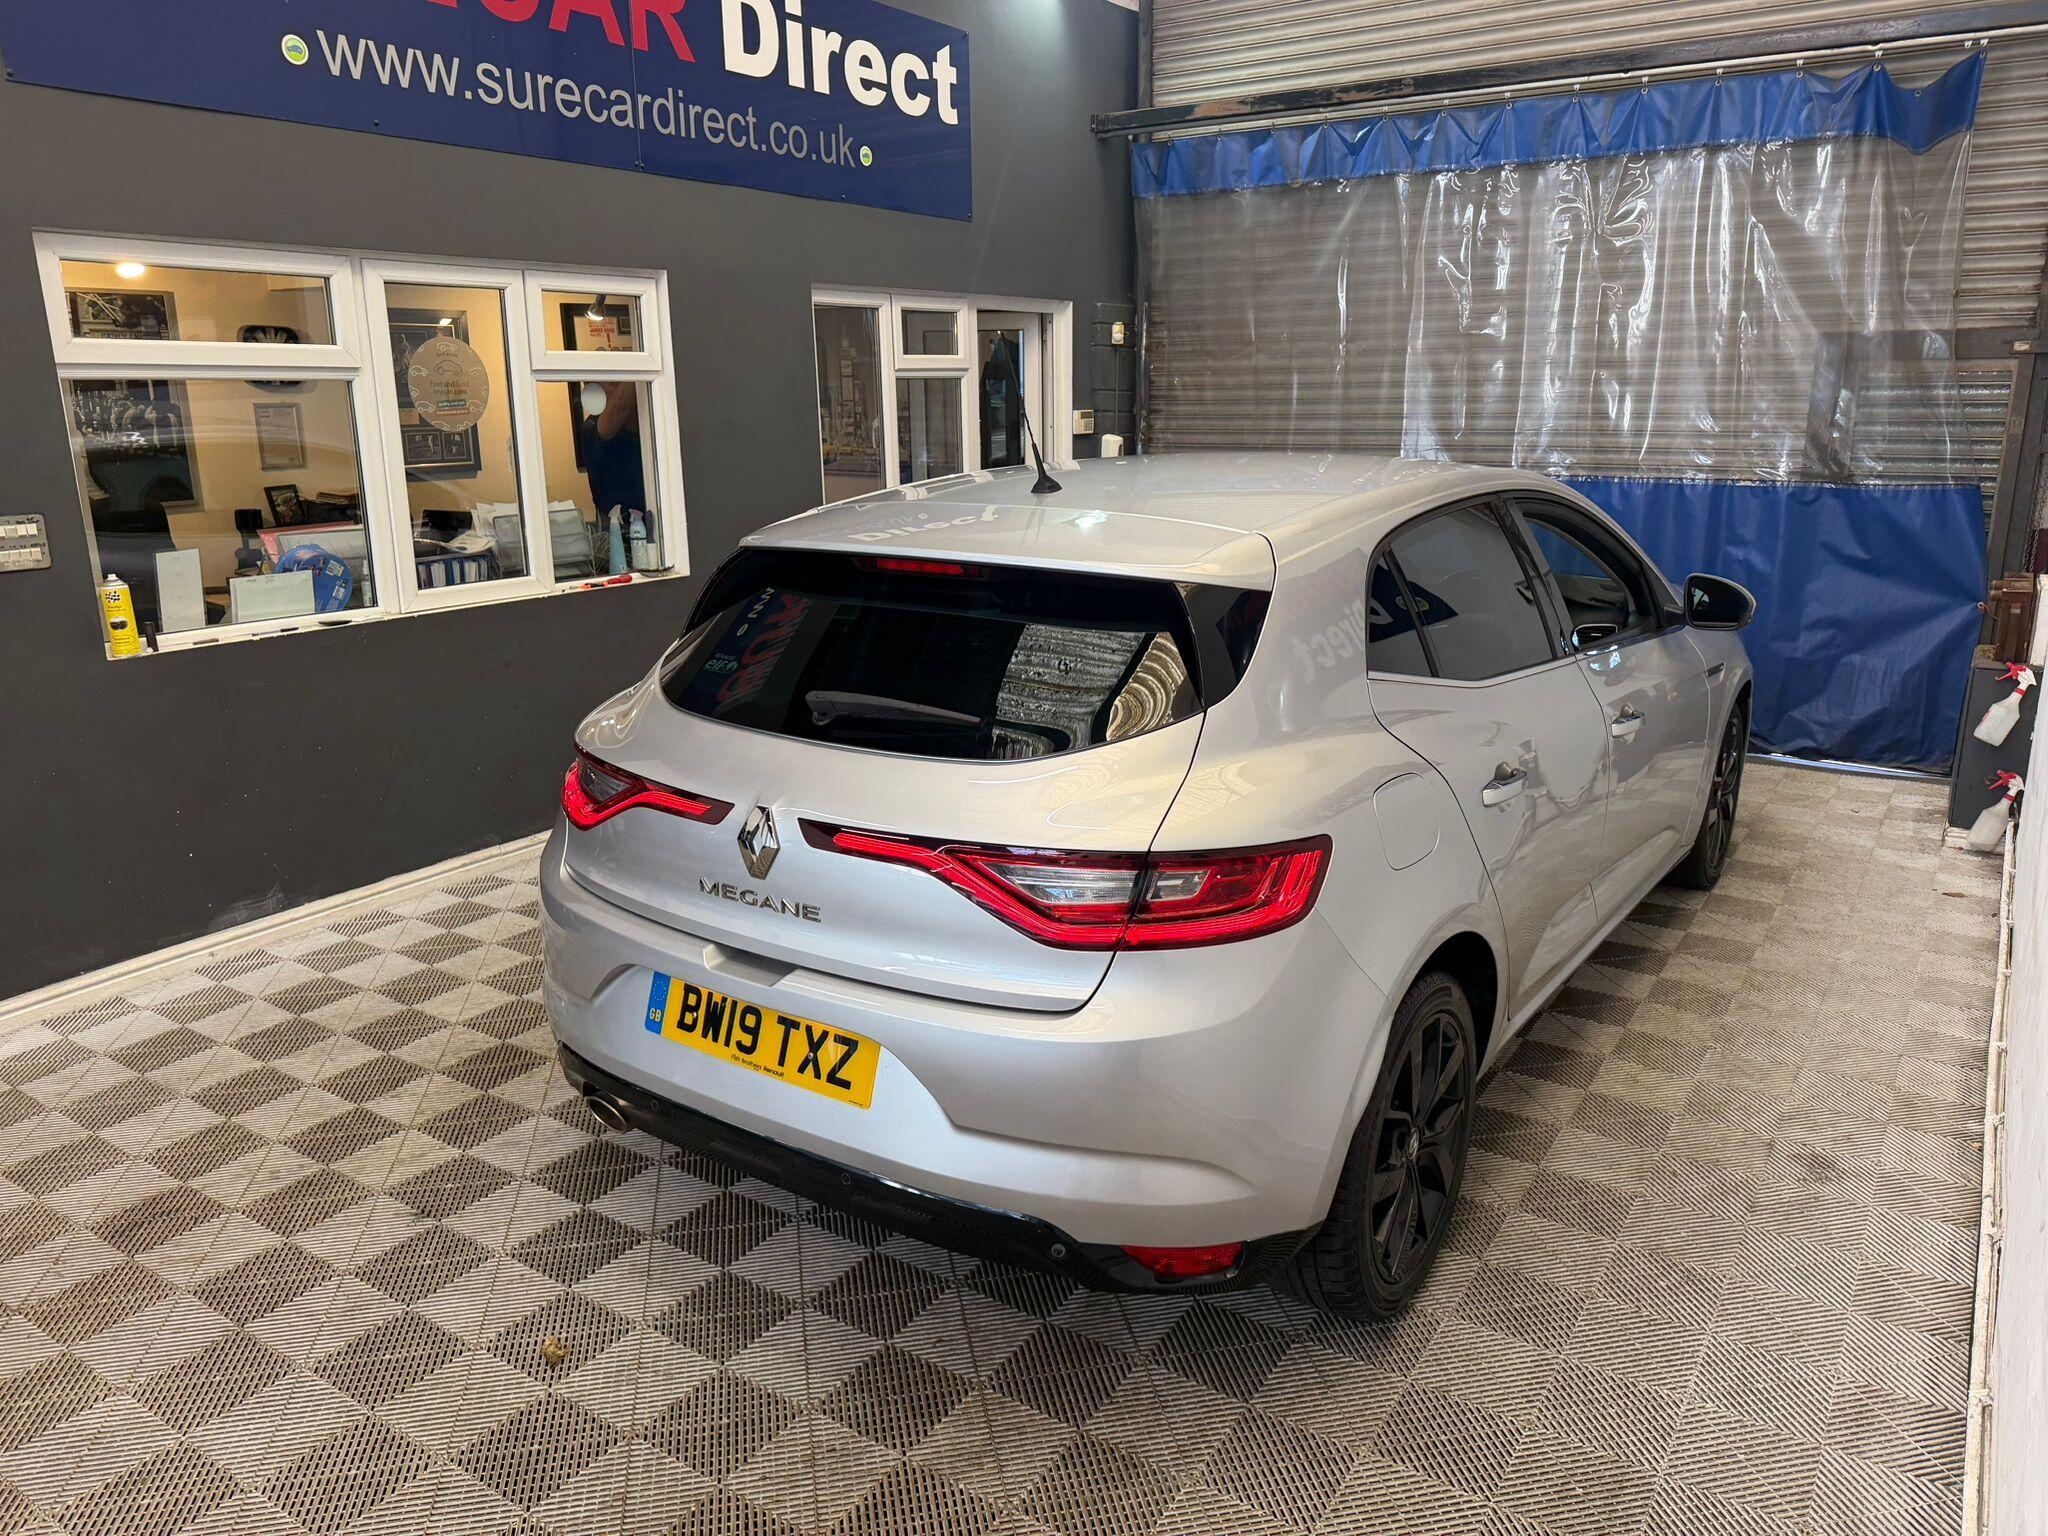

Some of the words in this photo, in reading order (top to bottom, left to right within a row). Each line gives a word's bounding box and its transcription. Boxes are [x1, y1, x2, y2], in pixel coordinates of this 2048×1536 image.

[315, 29, 856, 168] www.surecardirect.co.uk
[721, 0, 959, 125] Direct
[699, 877, 822, 922] MEGANE
[649, 1007, 662, 1022] GB
[676, 982, 762, 1056] BW19
[776, 1014, 859, 1090] TXZ
